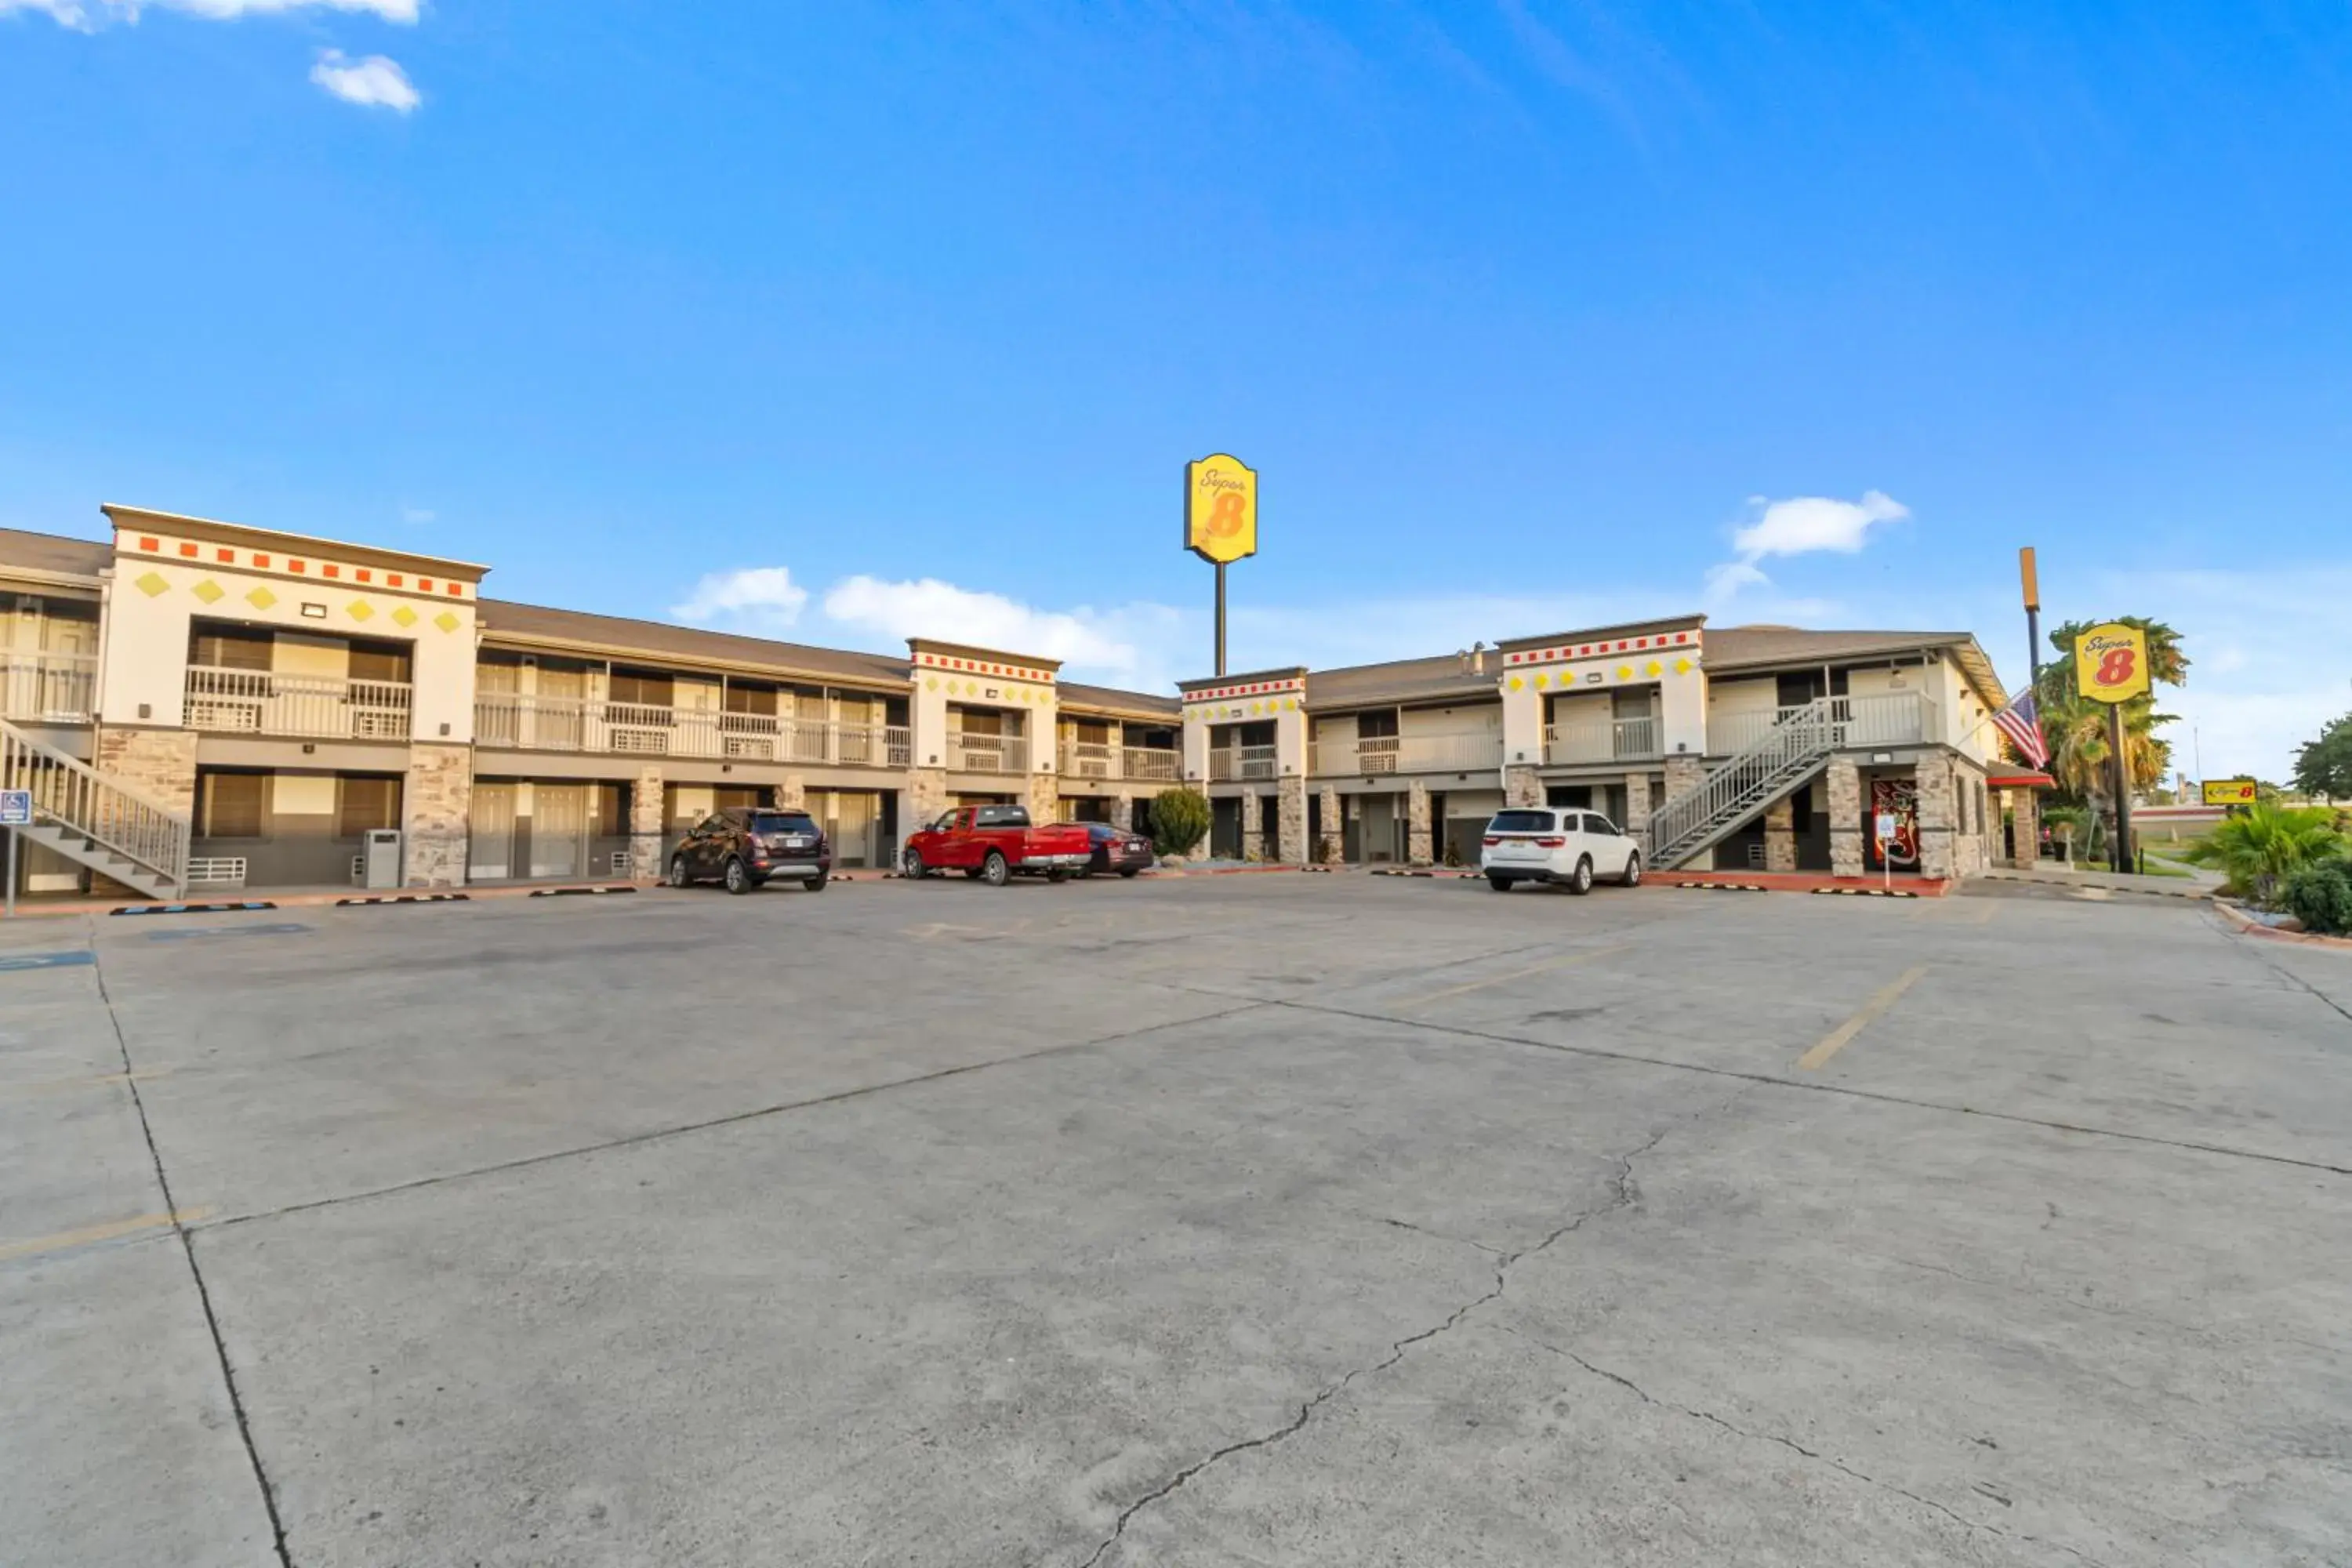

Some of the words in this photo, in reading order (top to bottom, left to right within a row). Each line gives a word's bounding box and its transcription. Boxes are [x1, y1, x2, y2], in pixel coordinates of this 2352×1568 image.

[1200, 468, 1247, 497] Super
[1208, 492, 1247, 538] 8
[2085, 635, 2133, 657] Super
[2096, 647, 2136, 686] 8
